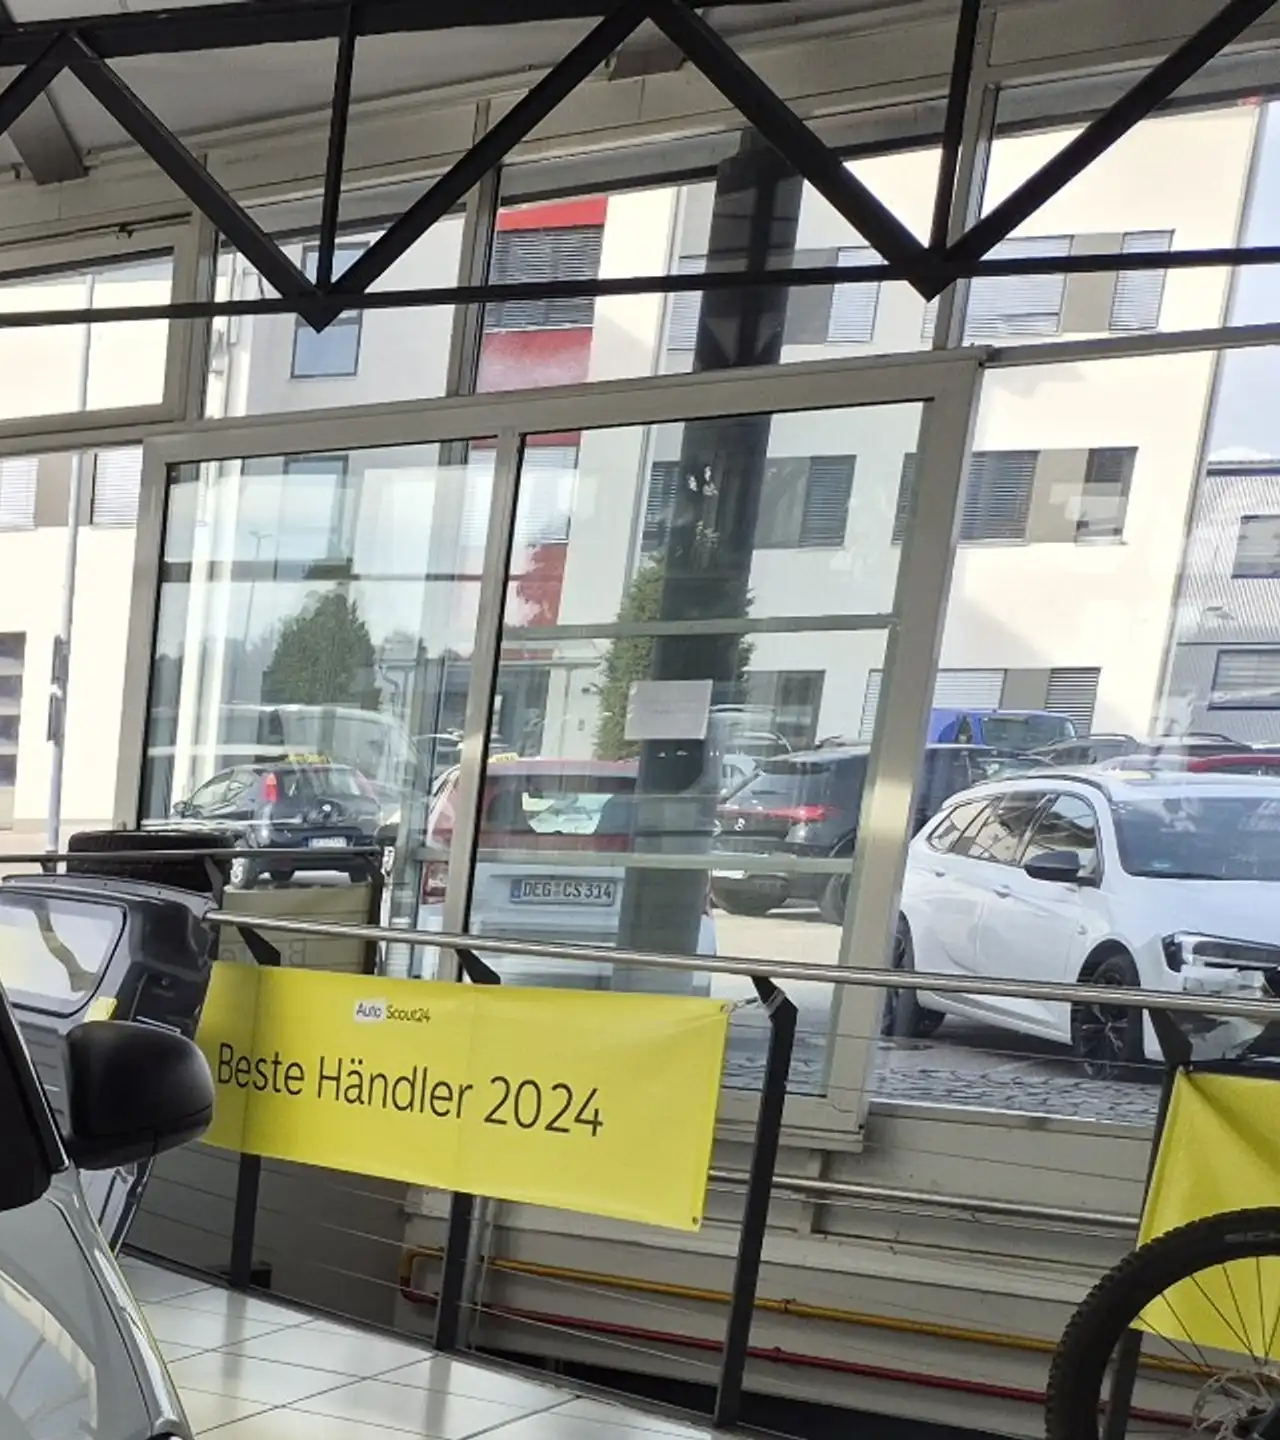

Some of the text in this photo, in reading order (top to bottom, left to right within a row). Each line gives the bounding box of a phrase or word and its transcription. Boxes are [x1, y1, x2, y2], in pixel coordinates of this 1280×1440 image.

[356, 1001, 431, 1023] Auto Scout24
[217, 1042, 604, 1138] Beste Händler 2024
